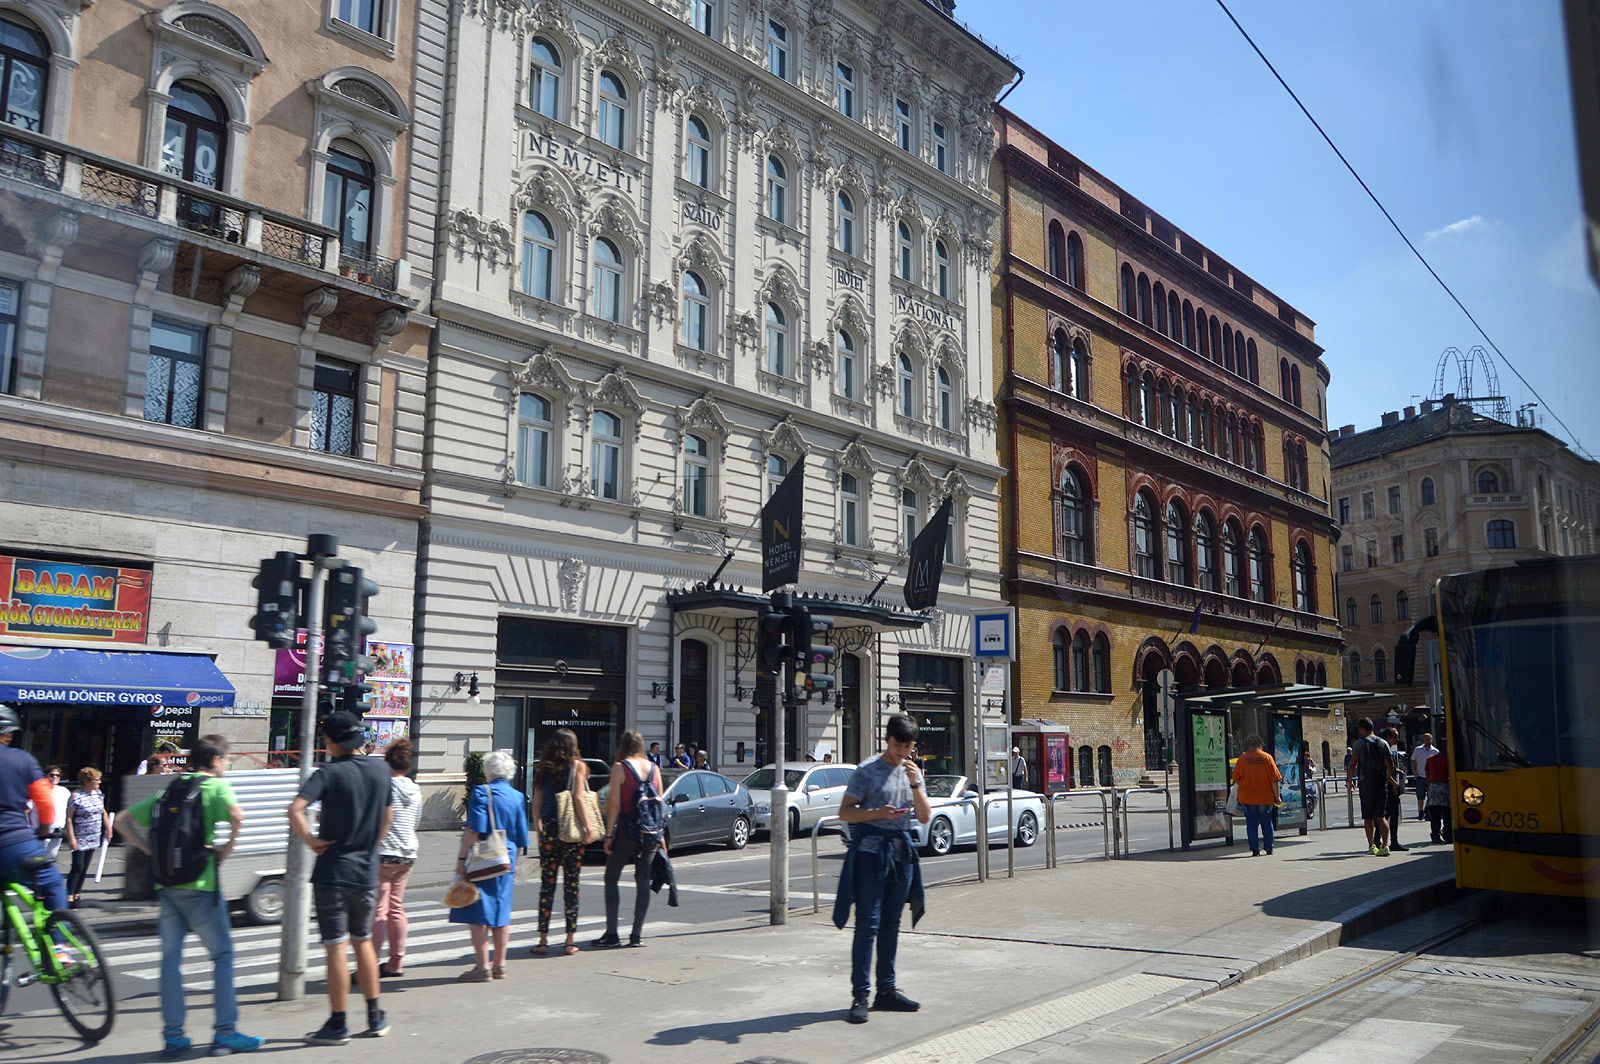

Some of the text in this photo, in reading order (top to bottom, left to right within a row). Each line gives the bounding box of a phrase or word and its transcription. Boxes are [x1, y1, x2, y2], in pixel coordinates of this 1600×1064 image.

[529, 132, 632, 193] NEMZETI
[837, 268, 864, 293] HOTEL
[898, 295, 957, 332] NATIONAL
[769, 541, 791, 556] HOTEL
[16, 569, 115, 600] BABAM
[33, 604, 141, 631] GYORSÉTTEREM
[18, 689, 163, 704] BABAM DÖNER GYROS
[201, 694, 224, 704] pepsi
[165, 706, 193, 716] pepsi
[150, 720, 192, 729] Falafel pita
[1490, 811, 1539, 829] 2035
